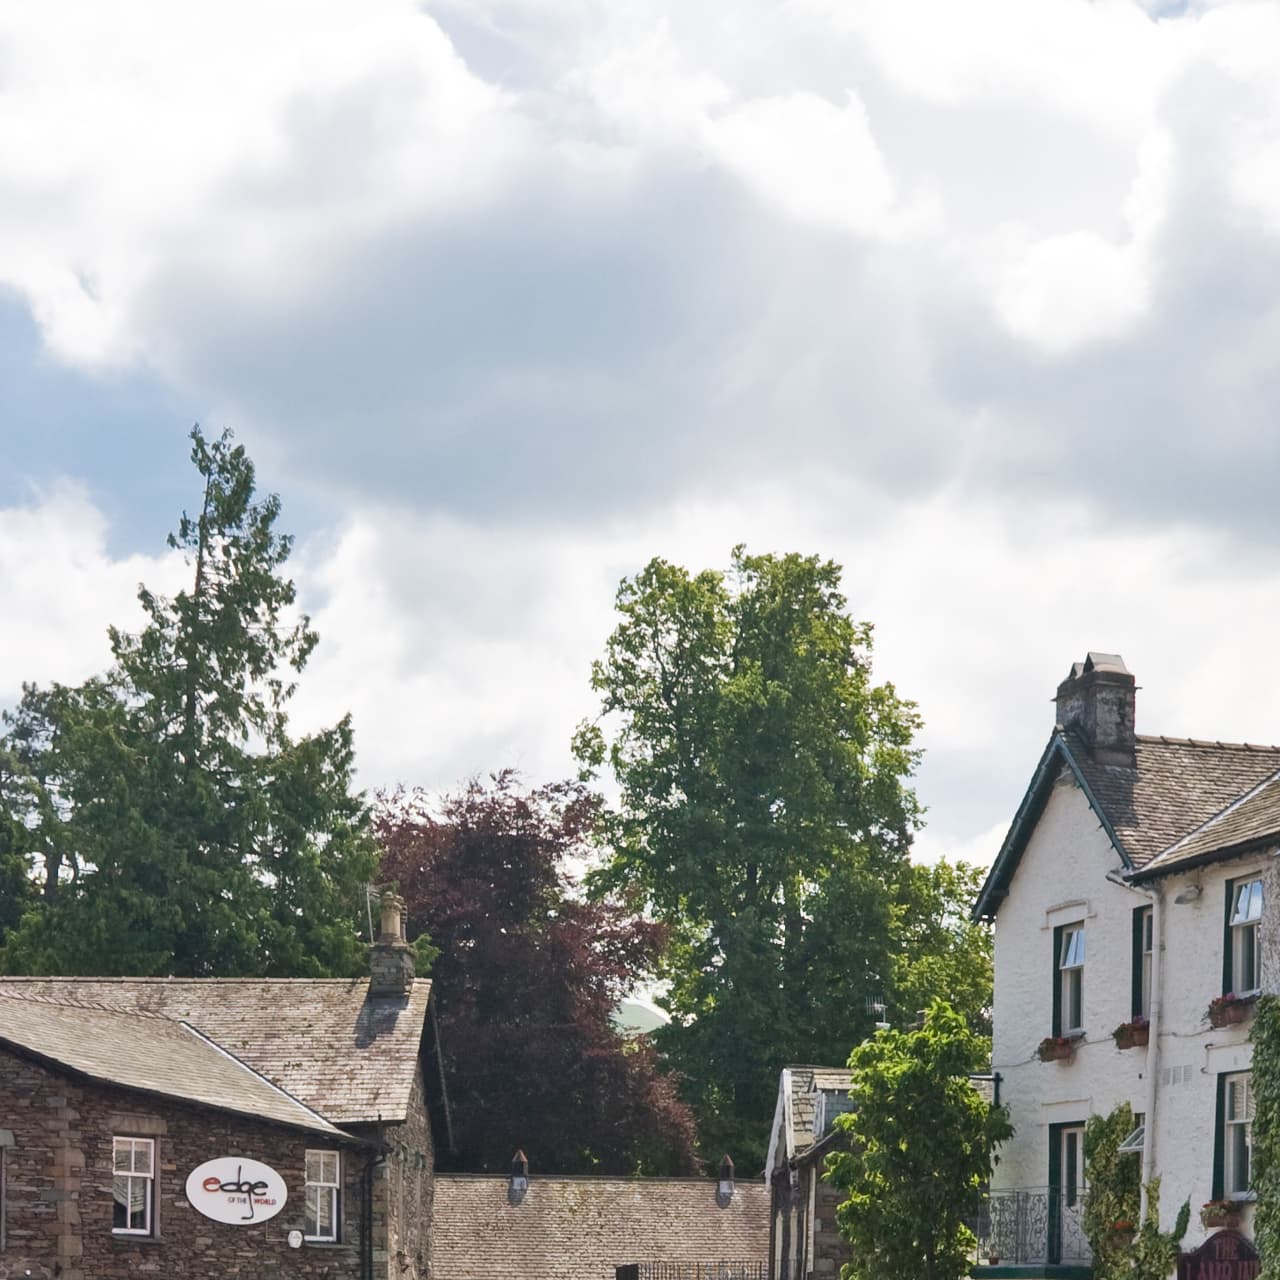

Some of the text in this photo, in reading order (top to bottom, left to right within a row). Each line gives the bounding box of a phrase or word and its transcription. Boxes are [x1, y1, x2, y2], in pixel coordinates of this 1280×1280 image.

[203, 1164, 268, 1220] edge
[253, 1198, 277, 1206] WORLD
[1215, 1238, 1238, 1260] THE
